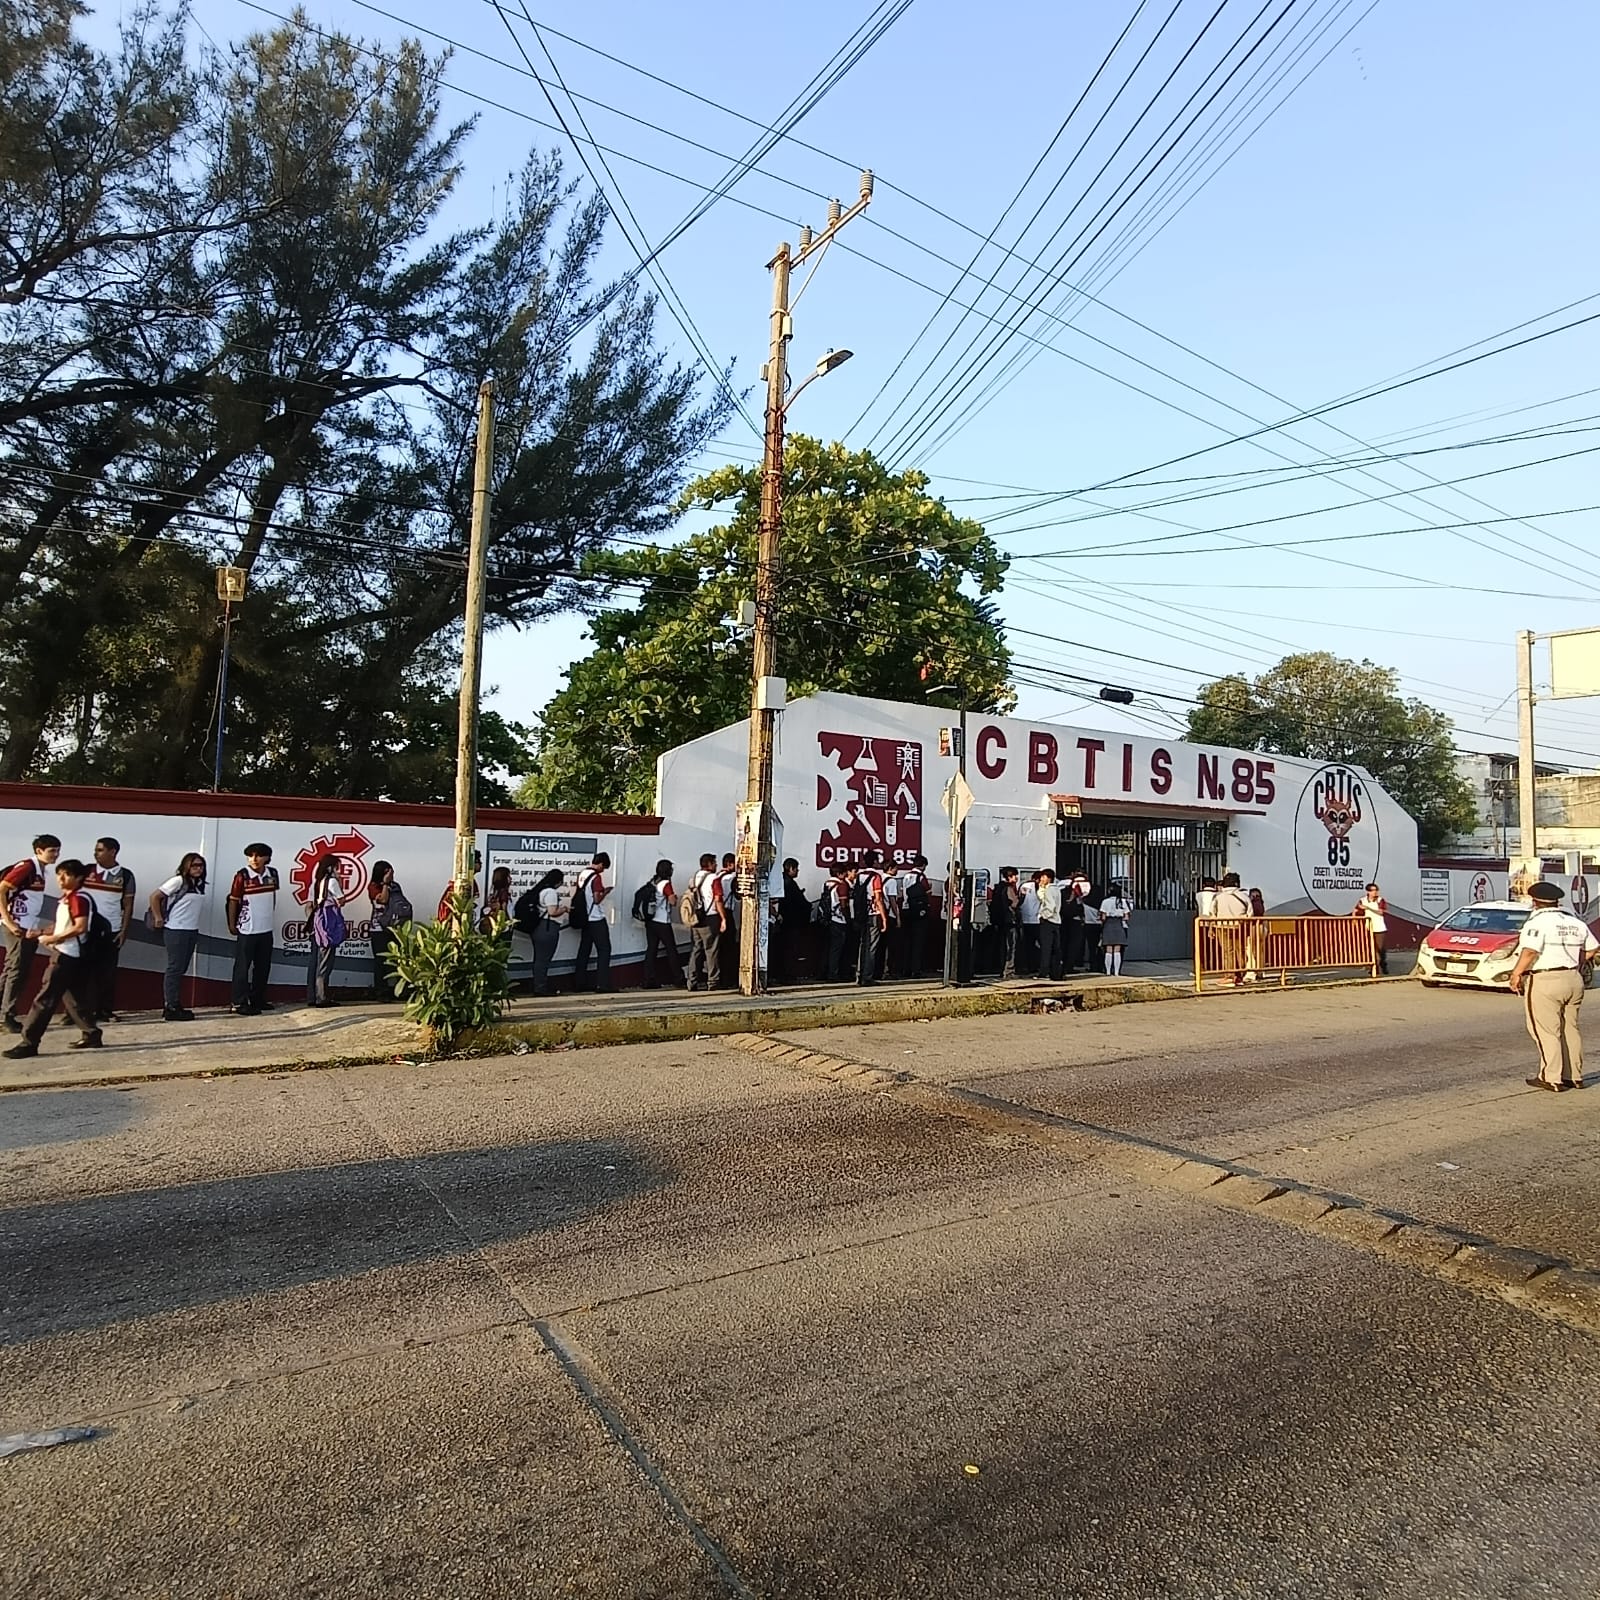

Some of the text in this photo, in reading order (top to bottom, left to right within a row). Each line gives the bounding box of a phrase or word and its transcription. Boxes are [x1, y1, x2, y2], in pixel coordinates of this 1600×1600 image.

[1314, 768, 1362, 823] CBTIS
[893, 849, 918, 865] 85
[1328, 836, 1351, 867] 85
[1335, 867, 1363, 877] VERACRUZ
[1312, 879, 1364, 890] COATZACOALCOS
